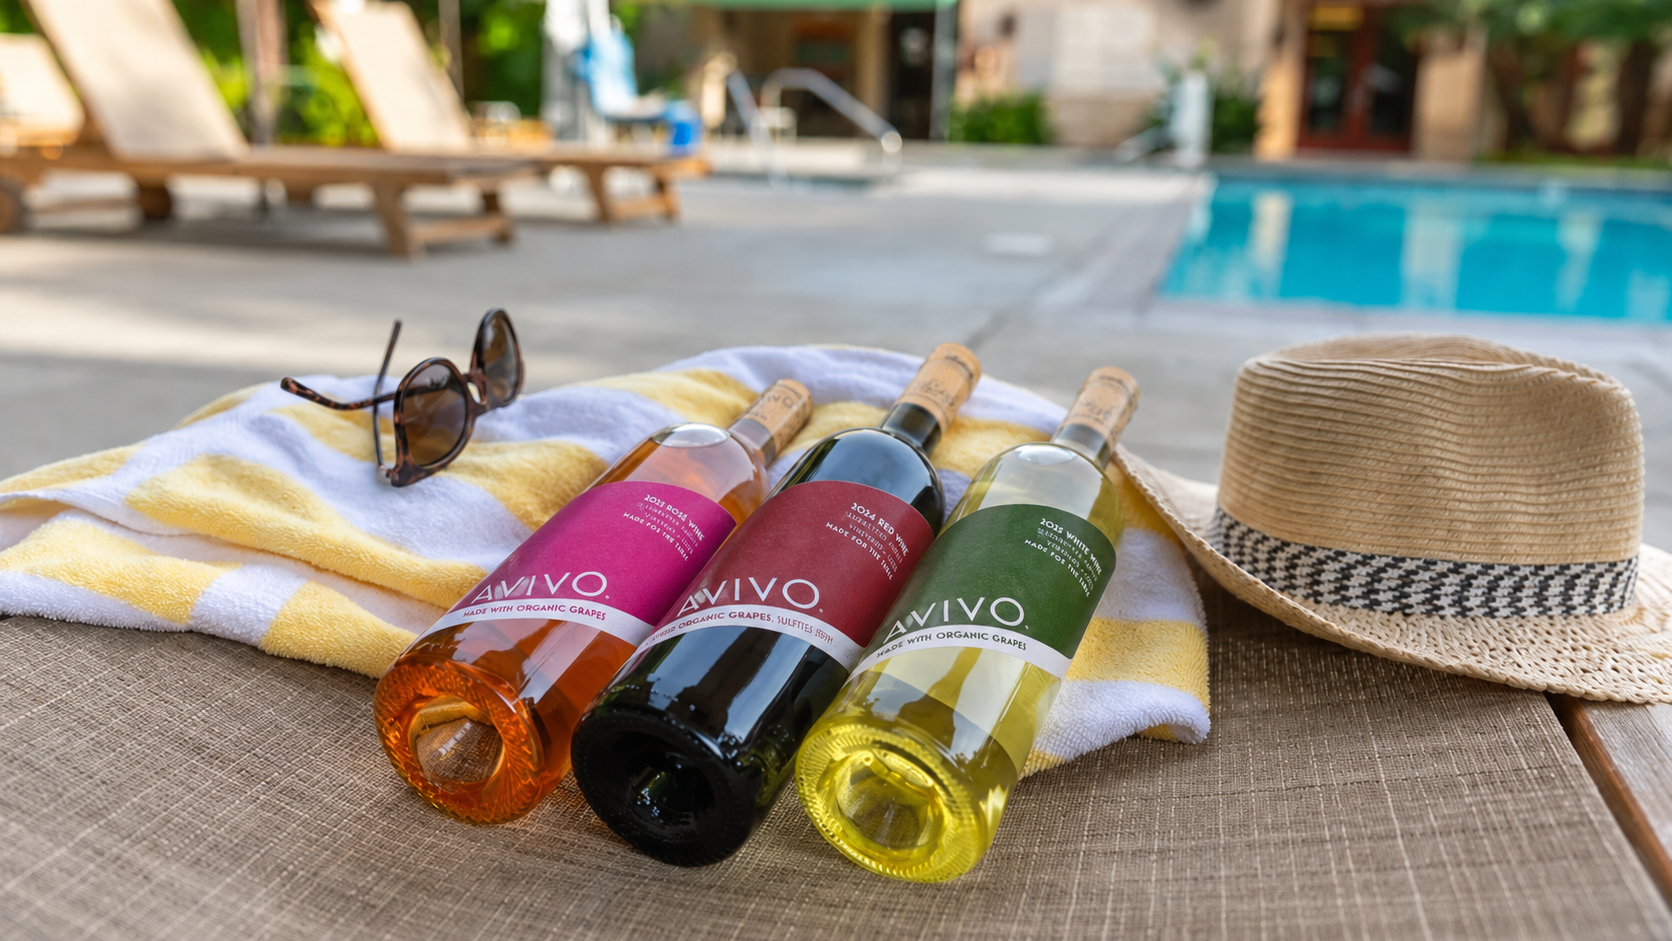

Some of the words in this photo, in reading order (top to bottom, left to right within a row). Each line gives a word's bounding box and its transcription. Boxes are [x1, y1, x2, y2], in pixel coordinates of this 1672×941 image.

[623, 512, 645, 524] MADE
[689, 519, 705, 541] WINE
[878, 518, 895, 535] RED
[896, 533, 909, 556] WINE
[826, 522, 850, 537] MADE
[851, 536, 867, 549] FOR
[869, 546, 881, 560] THE
[1025, 539, 1048, 553] MADE
[1066, 531, 1090, 555] WHITE
[463, 607, 488, 617] MADE
[491, 605, 513, 613] WITH
[516, 604, 567, 612] ORGANIC
[569, 605, 606, 621] GRAPES
[678, 611, 725, 629] ORGANIC
[728, 611, 774, 623] GRAPES,
[906, 633, 932, 645] WITH
[936, 630, 989, 641] ORGANIC
[992, 634, 1027, 651] GRAPES
